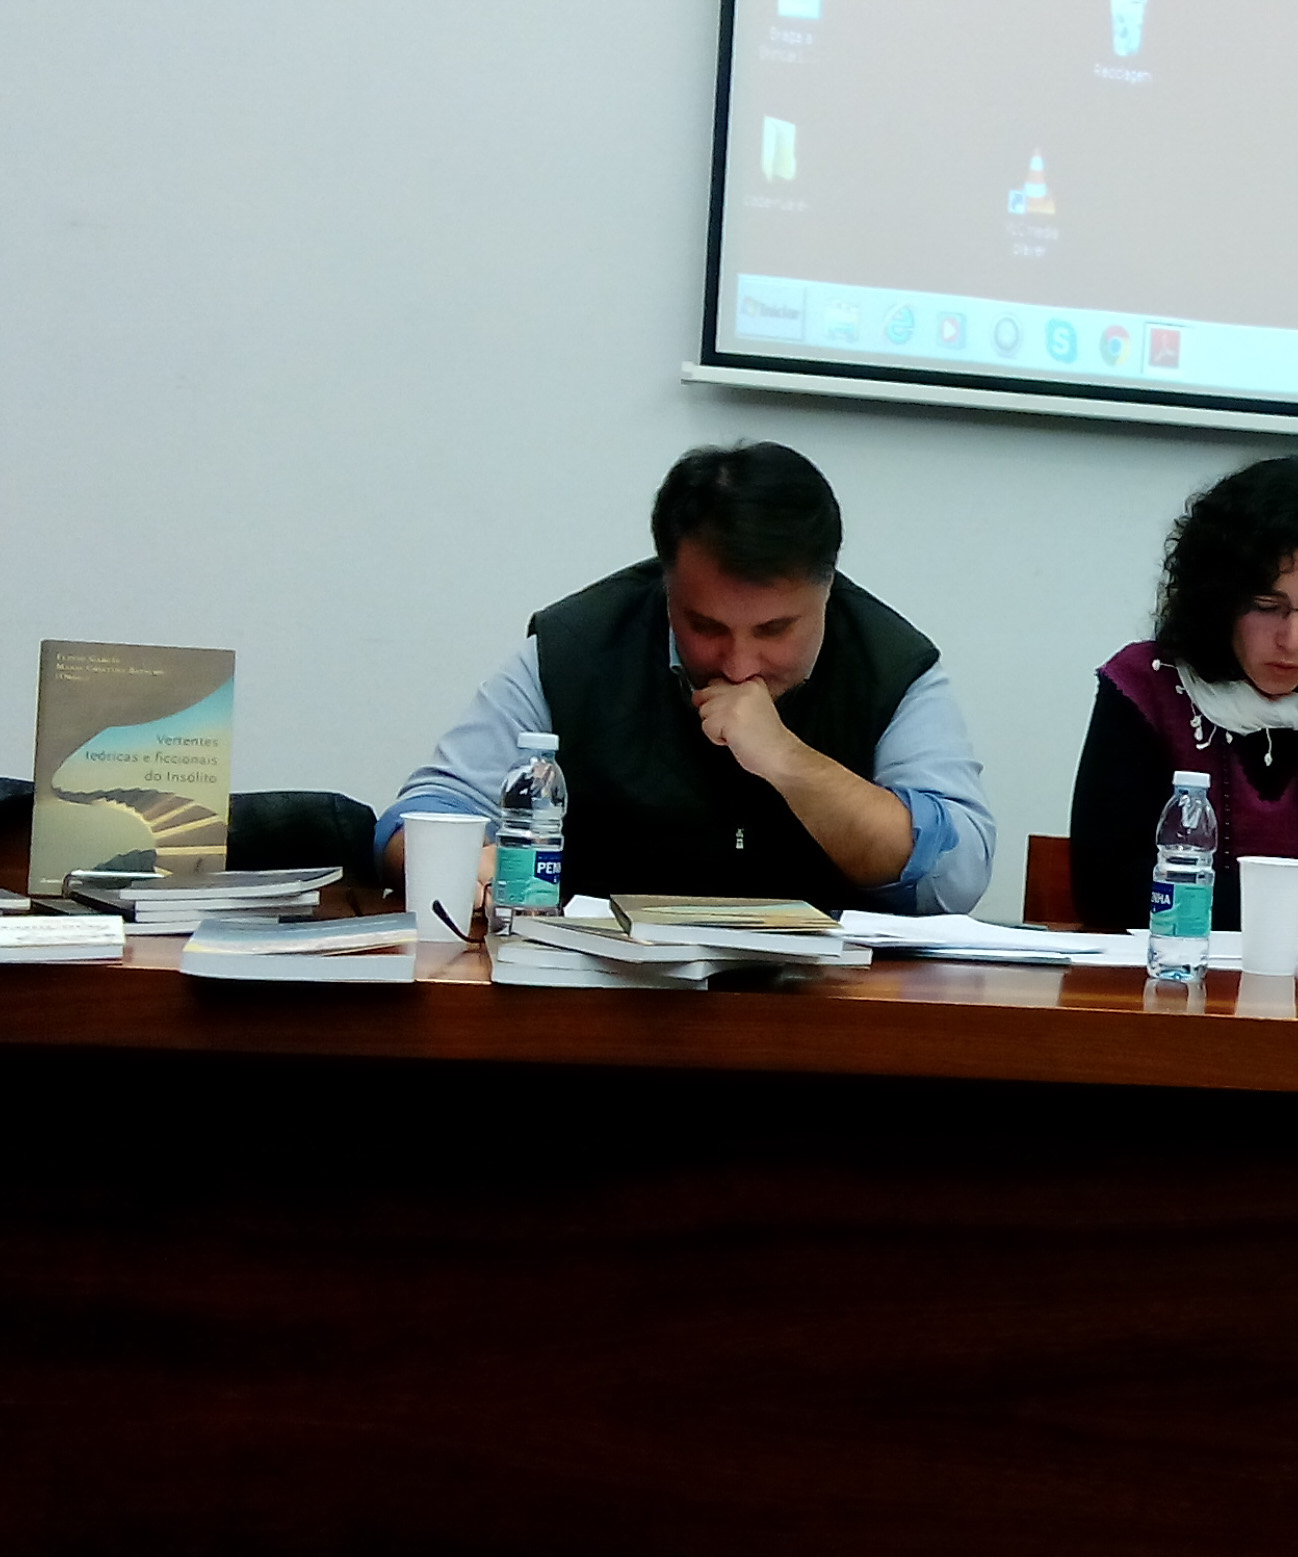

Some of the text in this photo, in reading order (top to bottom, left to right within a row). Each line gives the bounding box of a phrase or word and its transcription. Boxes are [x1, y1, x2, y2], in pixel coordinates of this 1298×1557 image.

[156, 733, 219, 747] Vertentes
[143, 755, 150, 763] e
[155, 751, 218, 766] ficcionais
[144, 771, 218, 784] do Insólito
